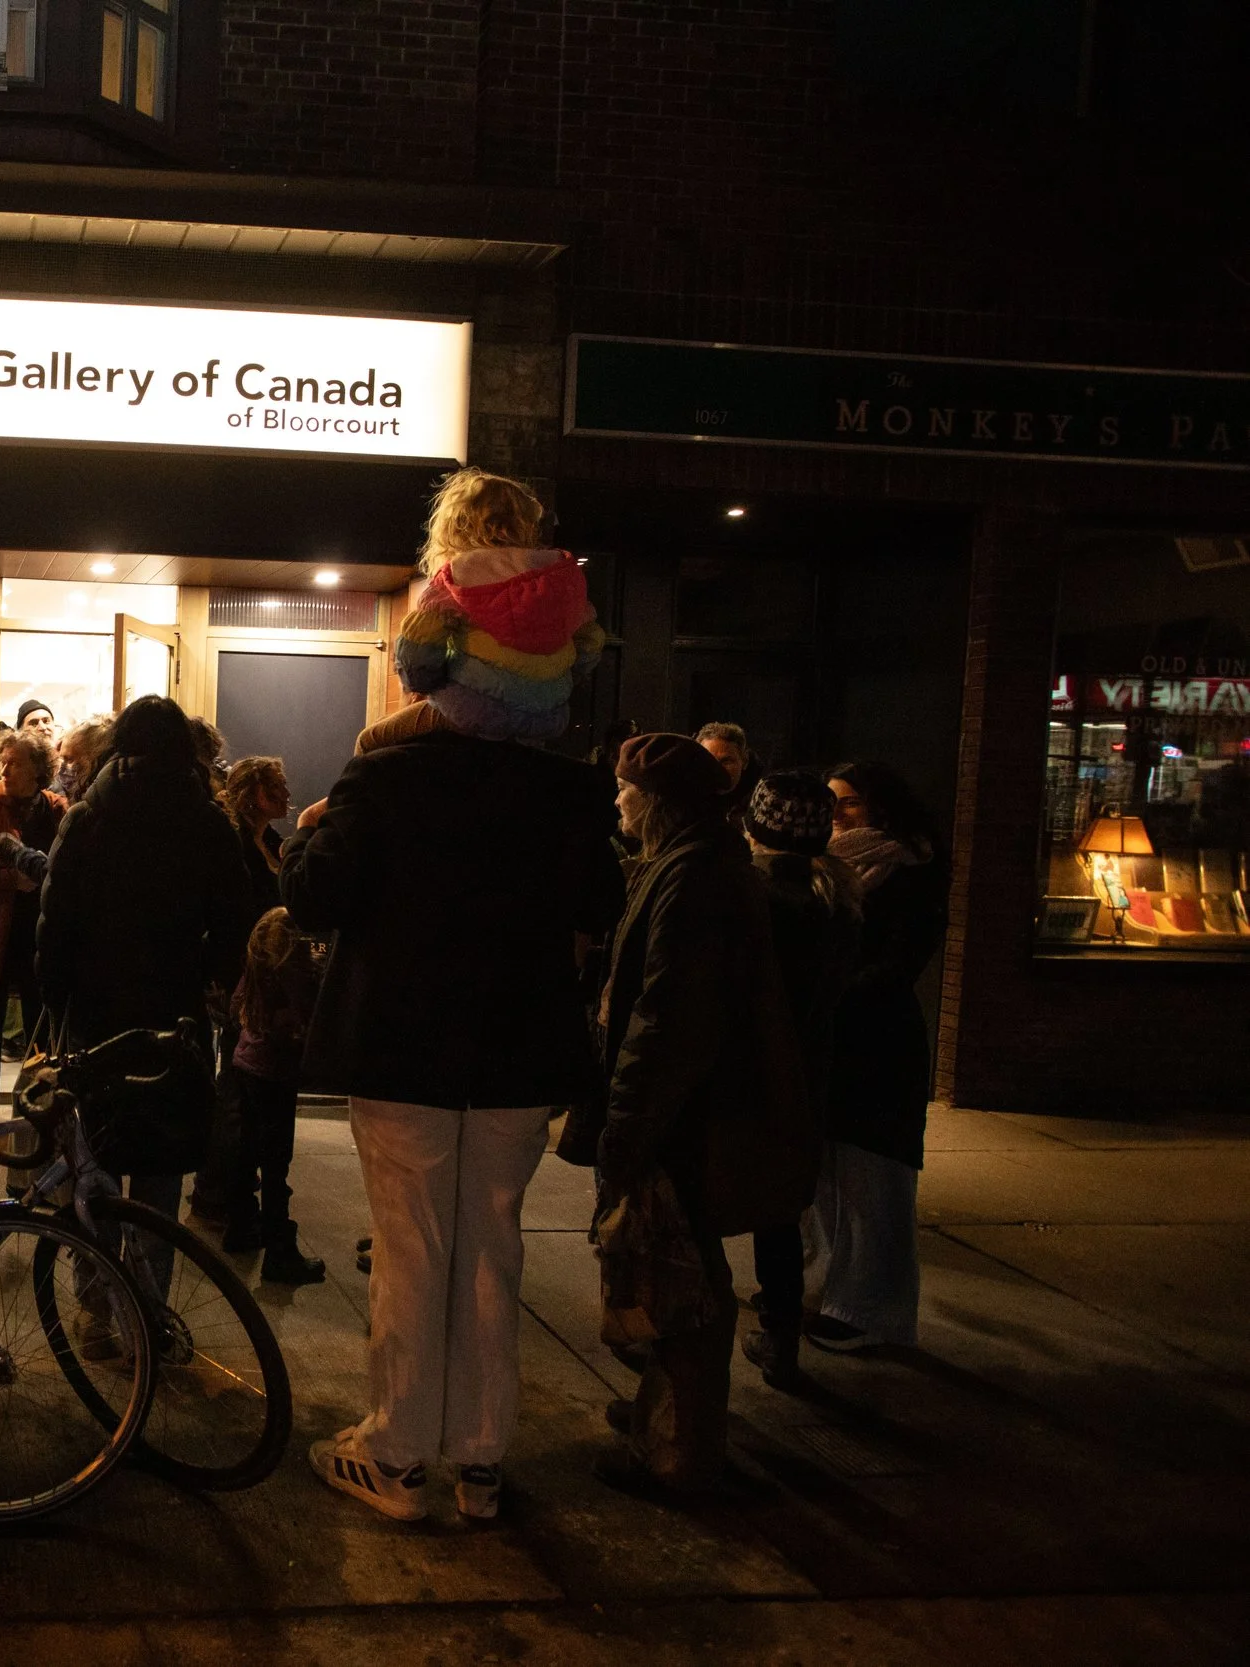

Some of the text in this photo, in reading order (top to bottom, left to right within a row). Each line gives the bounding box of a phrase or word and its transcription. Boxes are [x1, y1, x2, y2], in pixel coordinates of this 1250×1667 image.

[172, 359, 220, 397] of
[235, 363, 402, 408] Canada
[886, 371, 915, 389] The
[227, 407, 400, 436] of Bloorcourt
[694, 408, 729, 425] 1067
[1169, 412, 1250, 453] PA
[1141, 655, 1187, 674] OLD
